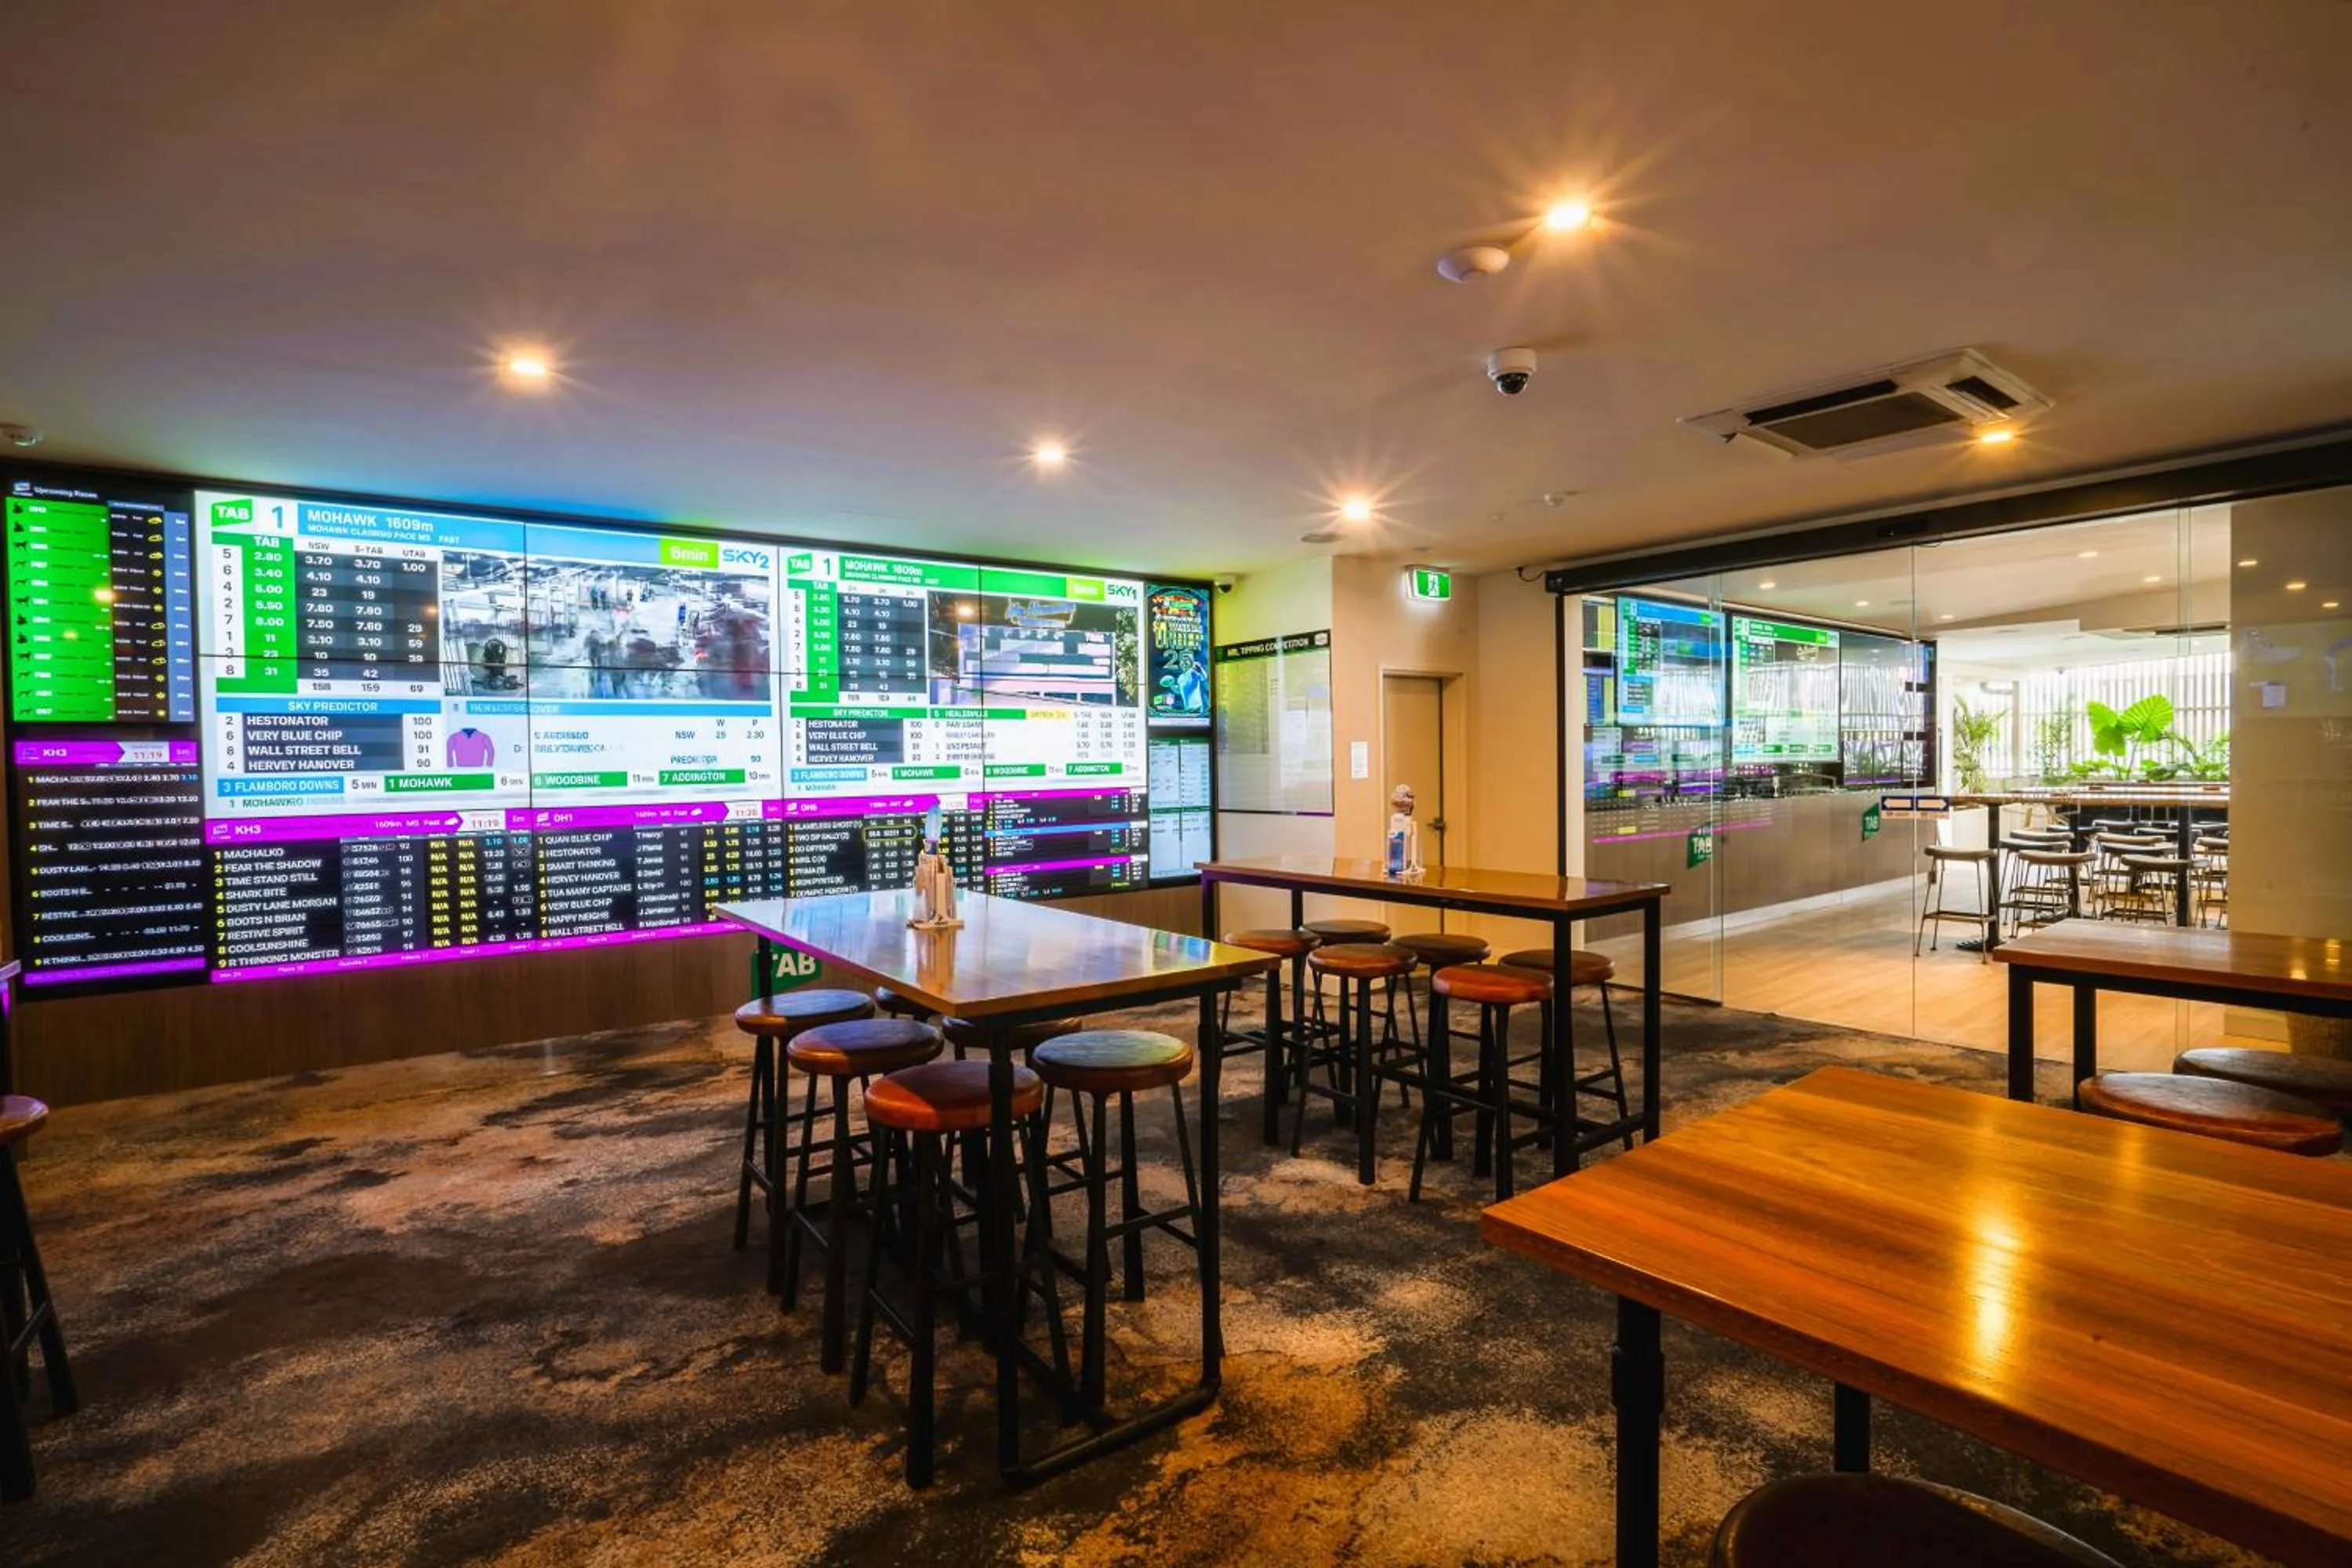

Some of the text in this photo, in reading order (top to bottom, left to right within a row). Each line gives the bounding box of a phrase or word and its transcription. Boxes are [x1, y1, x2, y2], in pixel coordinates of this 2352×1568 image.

[216, 506, 249, 521] TAB
[271, 506, 283, 528] 1
[307, 510, 433, 532] MOHAWK 1609m
[308, 524, 349, 534] MOHAWK
[350, 528, 391, 537] CLAIMING
[254, 536, 279, 548] TAB
[308, 542, 329, 550] NSW
[403, 550, 425, 558] UTAB
[223, 549, 426, 572] 5 3.70 3.70 1.00
[790, 558, 810, 568] TAB
[824, 558, 830, 575] 1
[845, 560, 887, 572] MOHAWK
[223, 565, 232, 575] 6
[307, 572, 332, 581] 4.10
[356, 575, 380, 585] 4.10
[223, 582, 232, 591] 4
[312, 588, 327, 597] 23
[224, 597, 232, 608] 2
[355, 606, 382, 615] 7.80
[224, 615, 232, 624] 7
[227, 631, 231, 640] 1
[263, 633, 276, 642] 11
[226, 648, 234, 659] 3
[226, 665, 234, 675] 8
[264, 666, 278, 676] 31
[363, 670, 378, 678] 42
[289, 702, 377, 711] SKY PREDICTOR
[226, 717, 234, 725] 2
[247, 716, 328, 725] HESTONATOR
[227, 731, 234, 740] 6
[247, 731, 279, 740] VERY
[281, 731, 312, 740] BLUE
[315, 730, 342, 740] CHIP
[227, 746, 234, 756] 8
[248, 746, 283, 755] WALL
[285, 746, 329, 755] STREET
[332, 746, 361, 754] BELL
[227, 761, 234, 770] 4
[249, 760, 296, 771] HERVEY
[299, 760, 354, 769] HANOVER
[389, 778, 452, 788] 1 MOHAWK
[546, 774, 601, 784] WOODBINE
[223, 781, 339, 793] 3 FLAMBORO DOWNS
[235, 825, 262, 834] KH3
[1693, 837, 1712, 853] TAB
[214, 851, 221, 860] 1
[214, 865, 223, 873] 2
[225, 863, 252, 872] FEAR
[276, 859, 321, 869] SHADOW
[215, 873, 318, 887] 3 TIME STAND STILL
[226, 890, 262, 899] SHARK
[263, 887, 287, 896] BITE
[227, 903, 262, 913] DUSTY
[292, 898, 337, 909] MORGAN
[227, 916, 263, 926] BOOTS
[264, 915, 272, 924] N
[274, 913, 306, 922] BRIAN
[228, 930, 270, 939] RESTIVE
[273, 926, 305, 936] SPIRIT
[289, 949, 339, 961] MONSTER
[771, 952, 815, 978] AB
